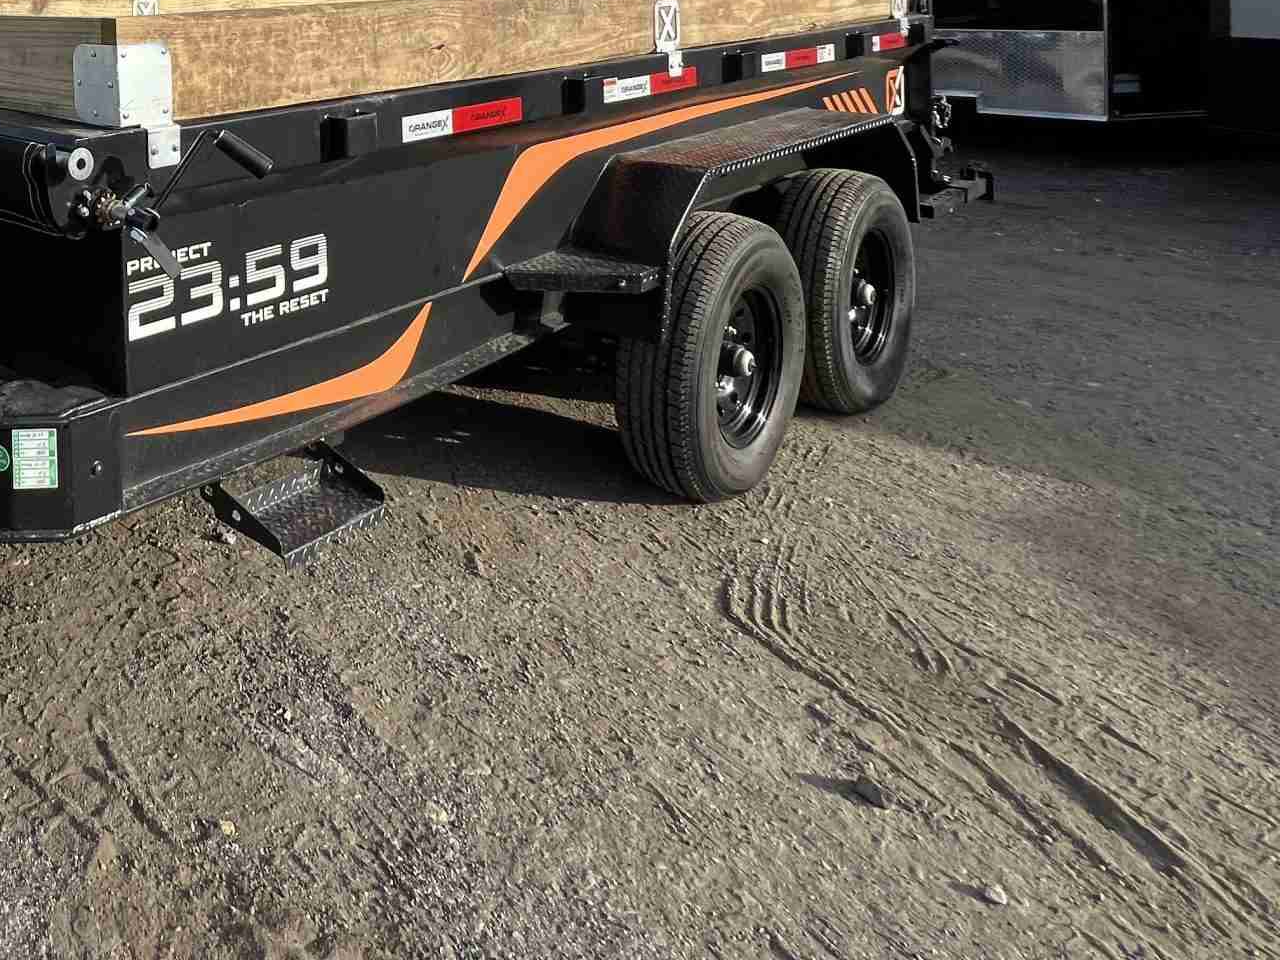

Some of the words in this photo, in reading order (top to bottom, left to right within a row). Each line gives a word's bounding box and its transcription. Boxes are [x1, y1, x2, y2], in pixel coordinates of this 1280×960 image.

[408, 115, 449, 134] ORANGEX
[126, 242, 212, 276] PRECT
[128, 233, 328, 342] 23:59
[240, 307, 275, 327] THE
[279, 289, 329, 316] RESET
